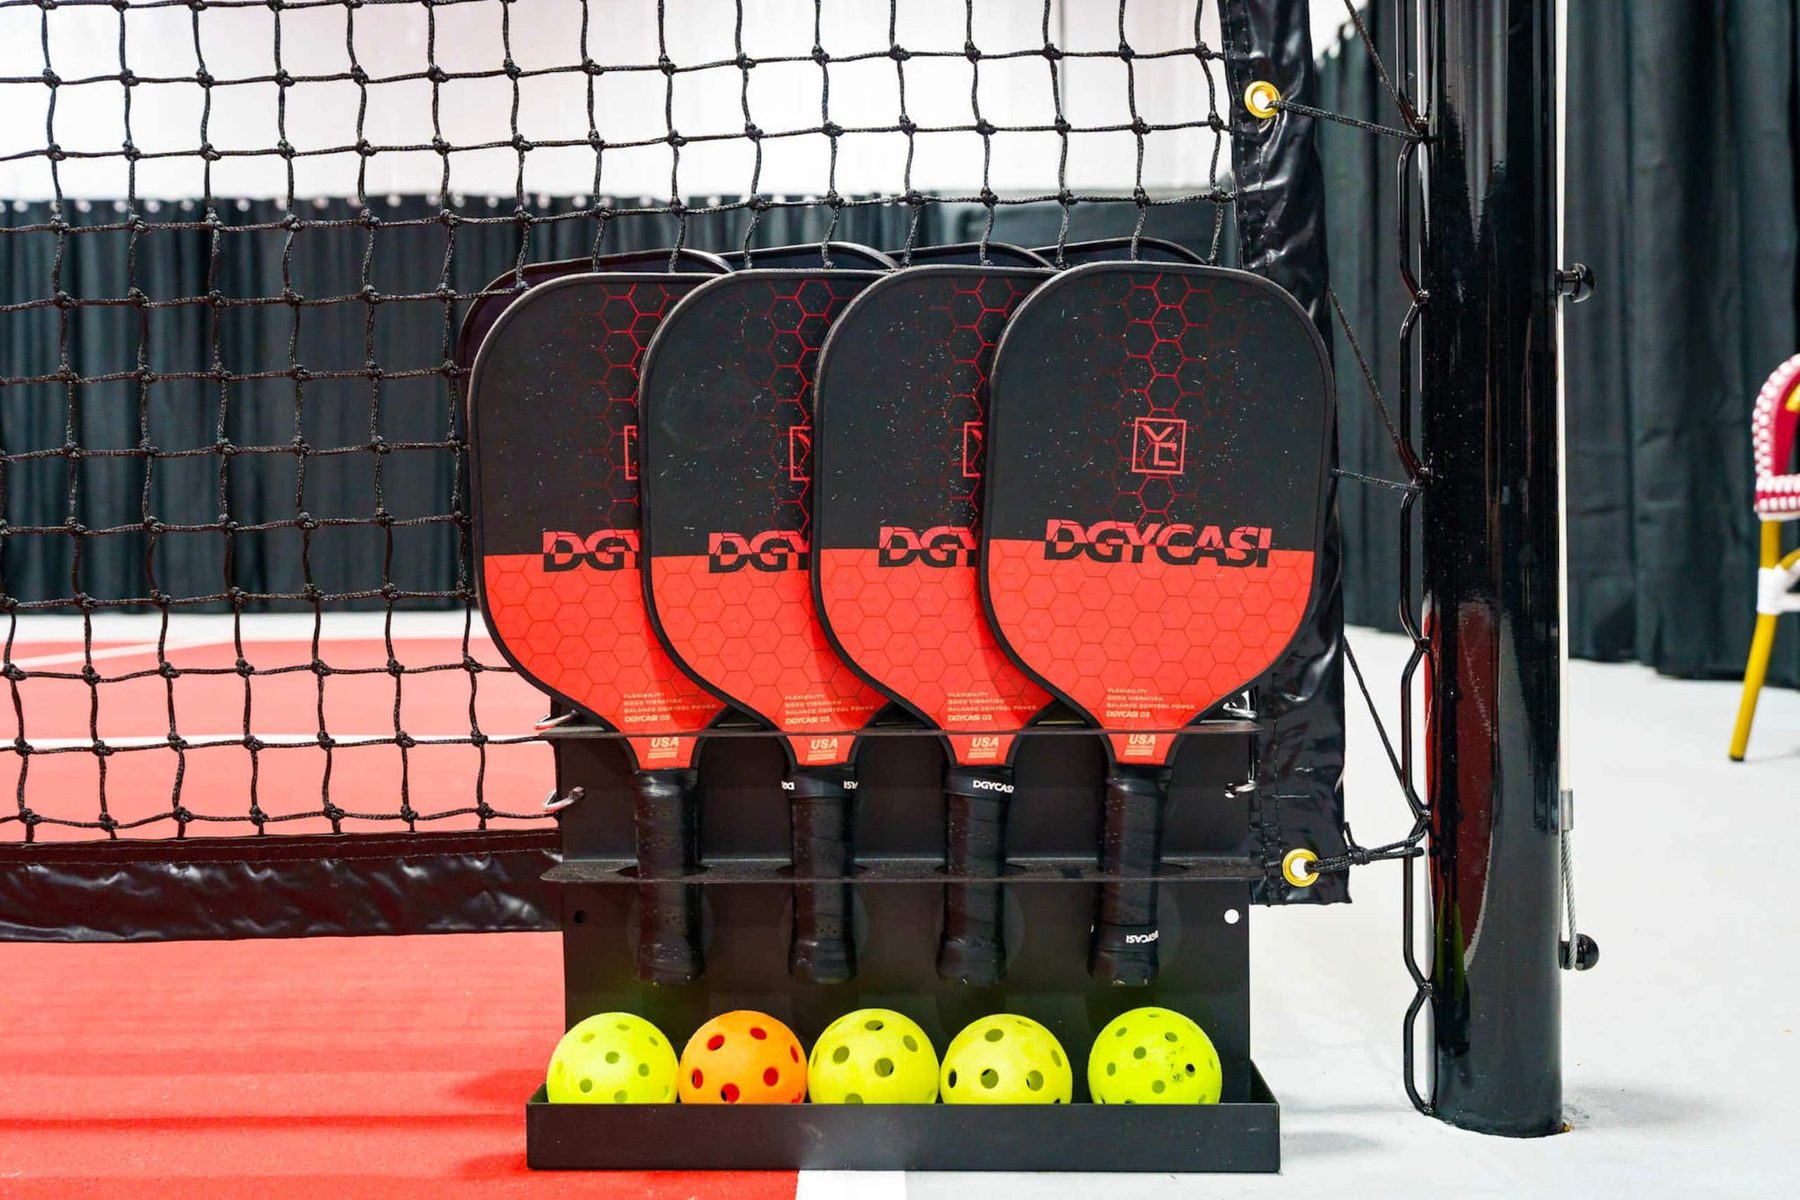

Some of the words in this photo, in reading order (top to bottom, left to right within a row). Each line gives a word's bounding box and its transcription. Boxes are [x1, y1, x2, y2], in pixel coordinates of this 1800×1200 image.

[1044, 519, 1273, 568] DGYCASI
[1106, 710, 1138, 718] DGYCASI
[651, 736, 679, 748] USA
[811, 738, 838, 750] USA
[971, 736, 999, 748] USA
[1128, 734, 1156, 745] USA
[972, 780, 1014, 794] DGYCASI
